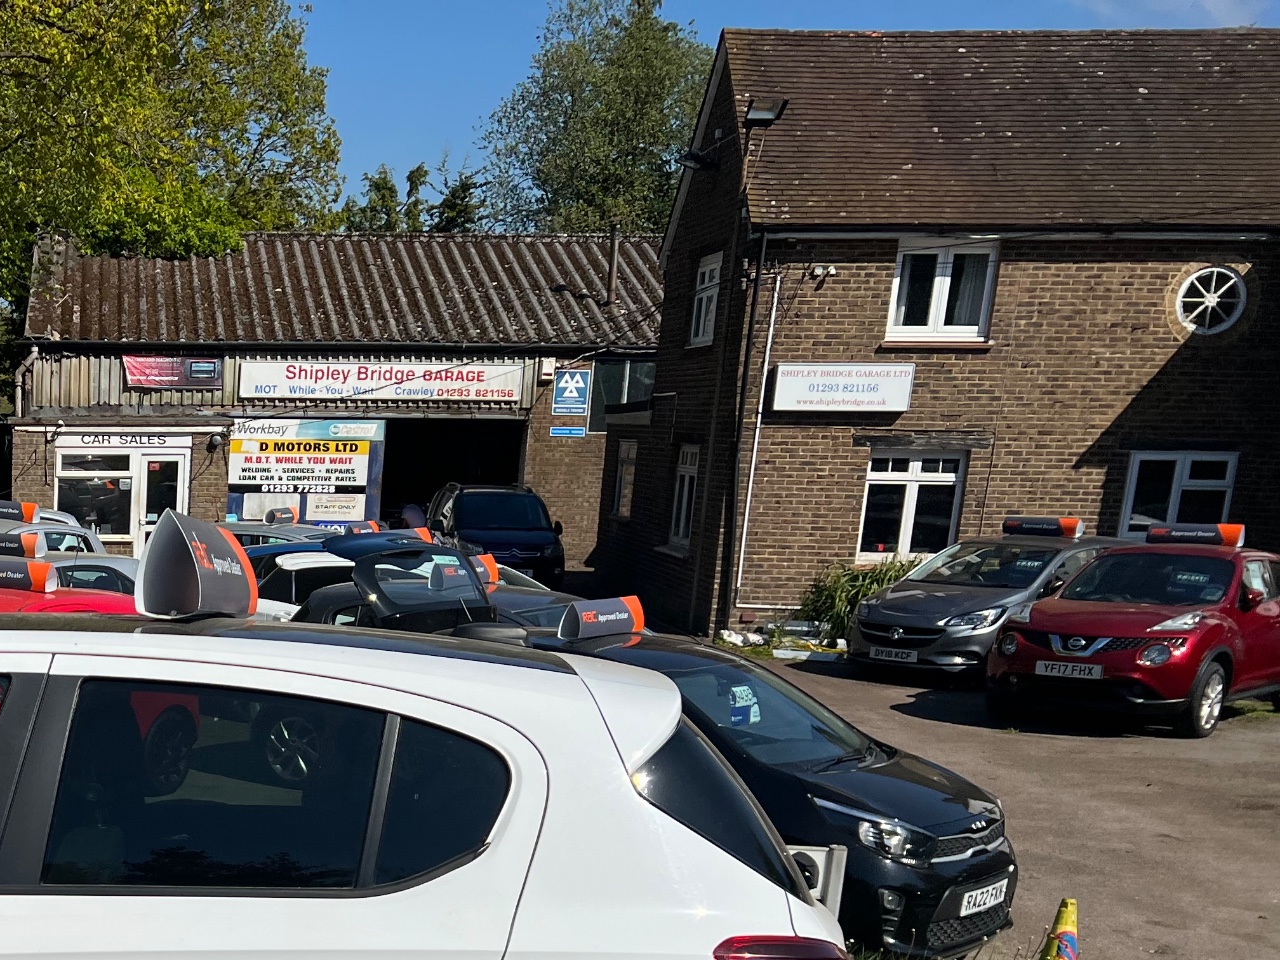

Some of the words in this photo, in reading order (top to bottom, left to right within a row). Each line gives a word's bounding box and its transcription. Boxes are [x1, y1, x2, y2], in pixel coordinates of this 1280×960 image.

[285, 365, 350, 384] Shipley
[356, 366, 416, 384] Bridge
[422, 369, 485, 382] GARAGE
[855, 370, 891, 378] GARAGE
[254, 384, 278, 395] MOT
[288, 385, 317, 395] While
[325, 386, 345, 396] You
[352, 385, 374, 396] Wait
[394, 386, 435, 397] Crawley
[437, 388, 470, 397] 01293
[475, 389, 514, 398] 821156
[808, 384, 839, 392] 01293
[842, 384, 879, 393] 821156
[796, 398, 886, 406] www.shipleybridge.co.uk
[237, 423, 288, 437] Workbay
[81, 434, 111, 445] CAR
[119, 435, 167, 445] SALES
[259, 442, 269, 451] D
[273, 442, 330, 452] MOTORS
[335, 442, 359, 452] LTD
[244, 456, 271, 464] M.O.T.
[275, 456, 304, 464] WHILE
[329, 457, 353, 465] WAIT
[261, 484, 294, 492] 01293
[296, 485, 336, 493] 772828
[7, 571, 24, 579] Dealer
[893, 650, 912, 660] KCF
[1044, 663, 1068, 675] YF17
[1070, 665, 1095, 676] FHX
[965, 890, 989, 911] RA22
